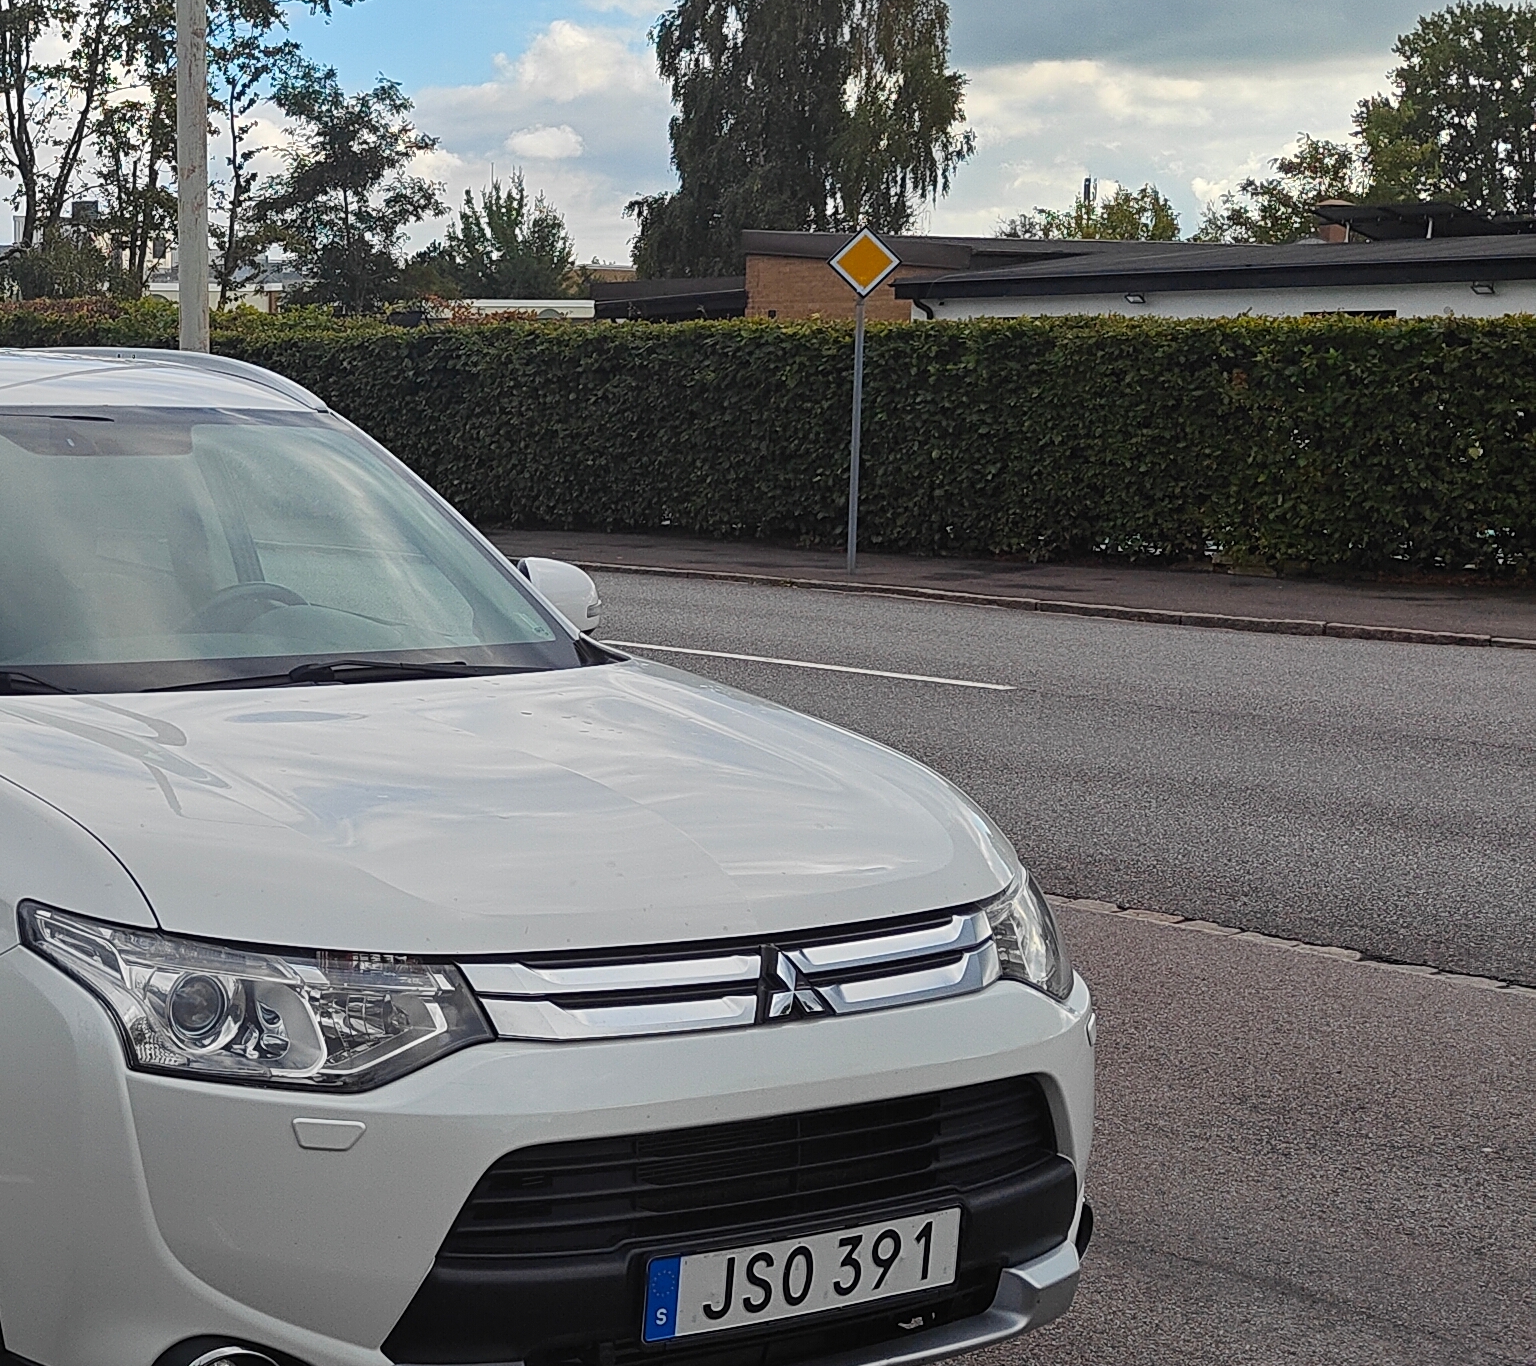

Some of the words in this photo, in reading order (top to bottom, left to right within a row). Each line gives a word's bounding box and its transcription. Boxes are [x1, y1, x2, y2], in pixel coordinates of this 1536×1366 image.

[703, 1245, 814, 1320] JSO
[833, 1221, 934, 1296] 391
[655, 1308, 668, 1325] S
